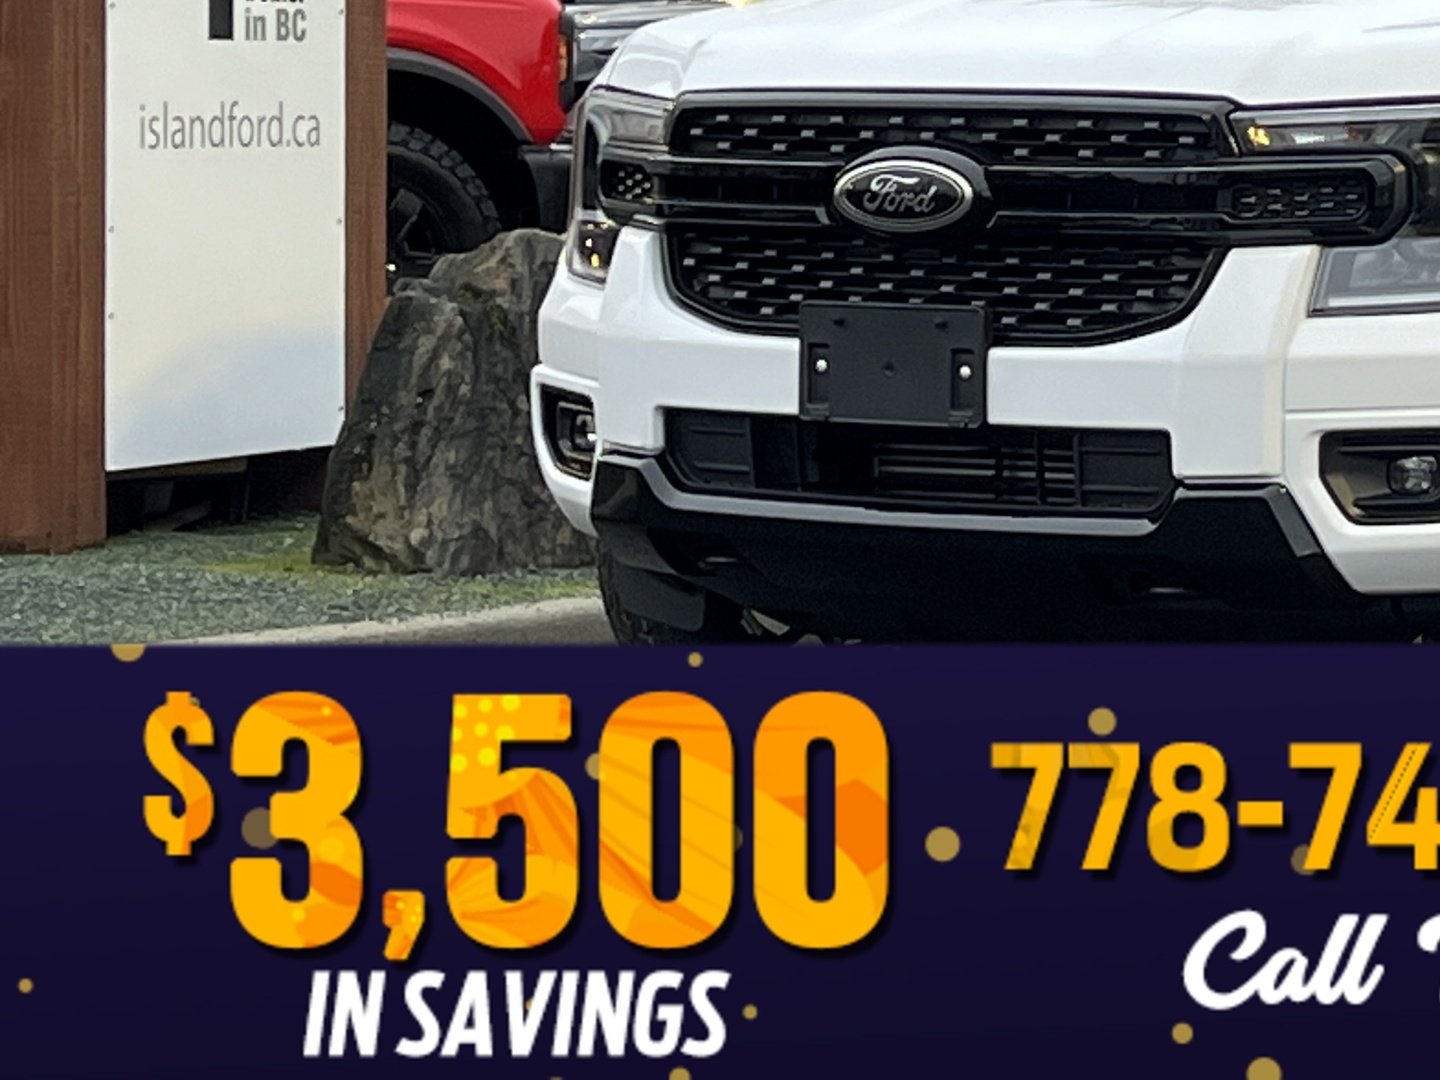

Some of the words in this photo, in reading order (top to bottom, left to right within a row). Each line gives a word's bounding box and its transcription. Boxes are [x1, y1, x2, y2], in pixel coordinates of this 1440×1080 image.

[245, 7, 267, 41] in
[276, 9, 307, 42] BC
[139, 100, 321, 150] islandford.ca
[863, 174, 937, 212] Ford
